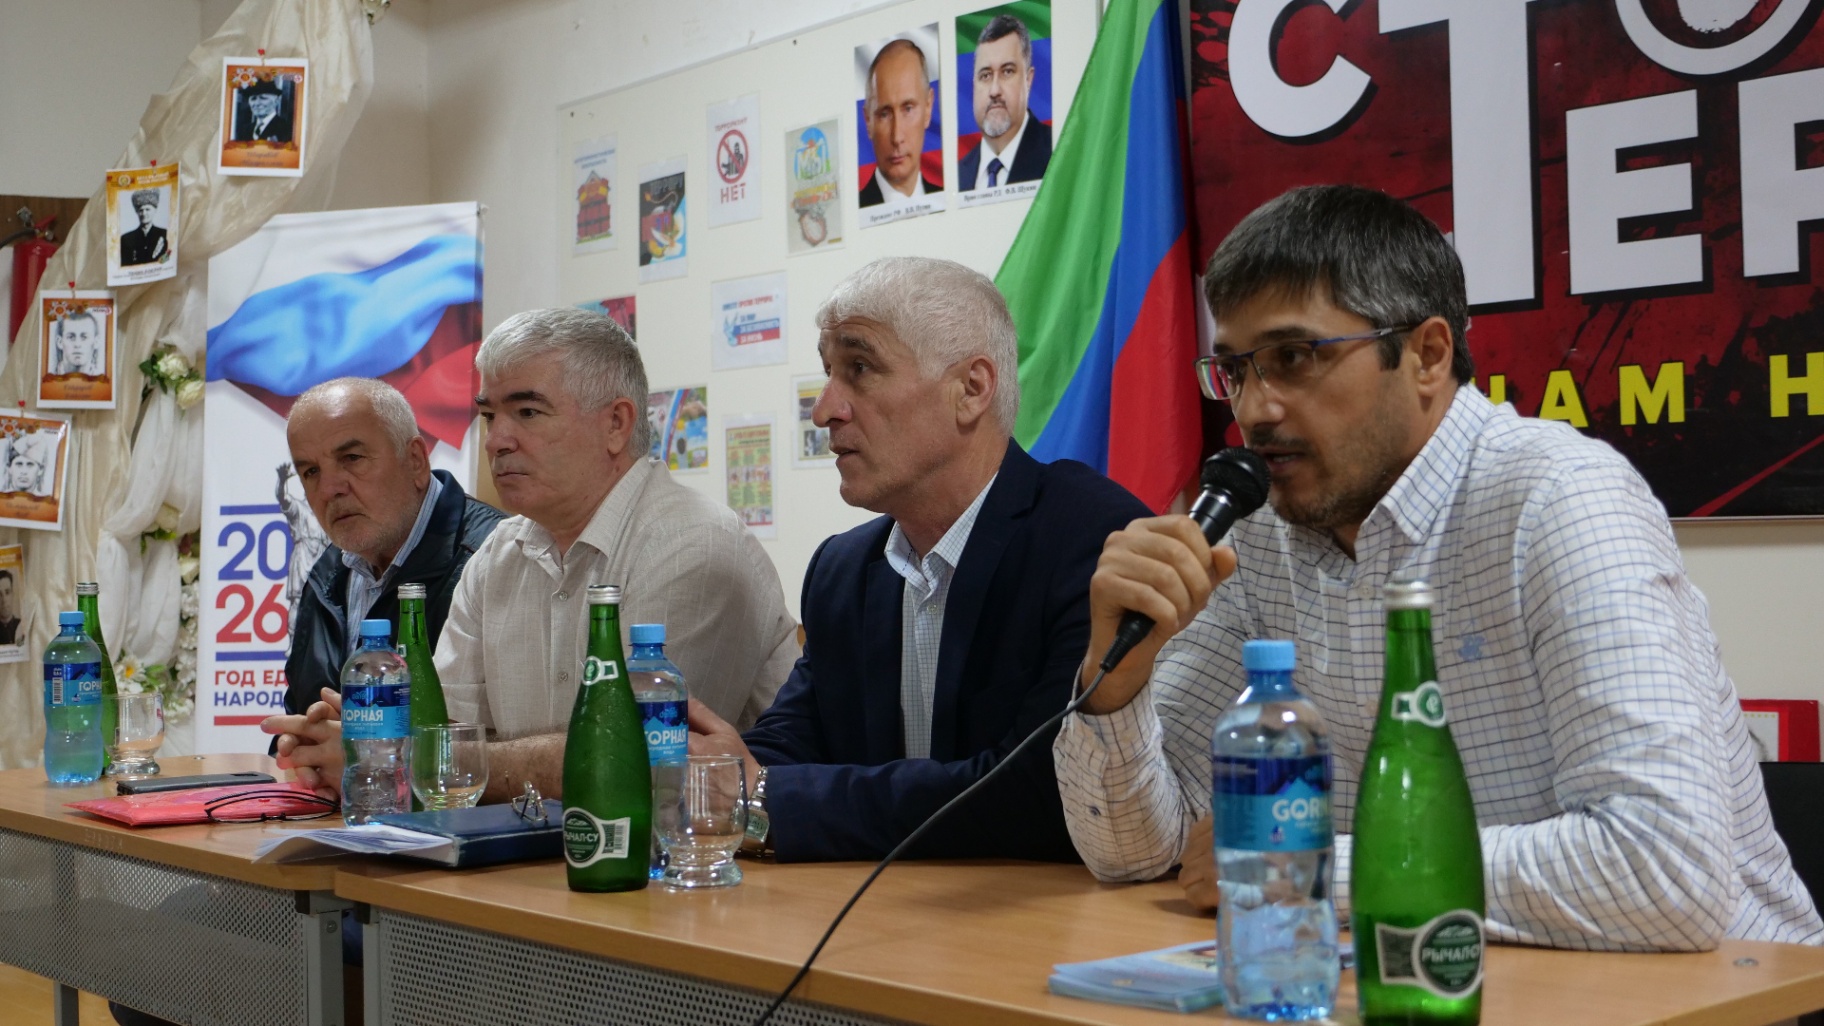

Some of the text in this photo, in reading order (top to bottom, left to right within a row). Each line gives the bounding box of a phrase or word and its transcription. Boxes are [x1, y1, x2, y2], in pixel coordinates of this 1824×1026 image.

[720, 182, 747, 204] НЕТ
[217, 520, 295, 581] 20
[215, 583, 290, 644] 26
[214, 670, 256, 688] ГОД
[213, 690, 285, 708] НАРОД
[644, 728, 687, 745] ОРНАЯ
